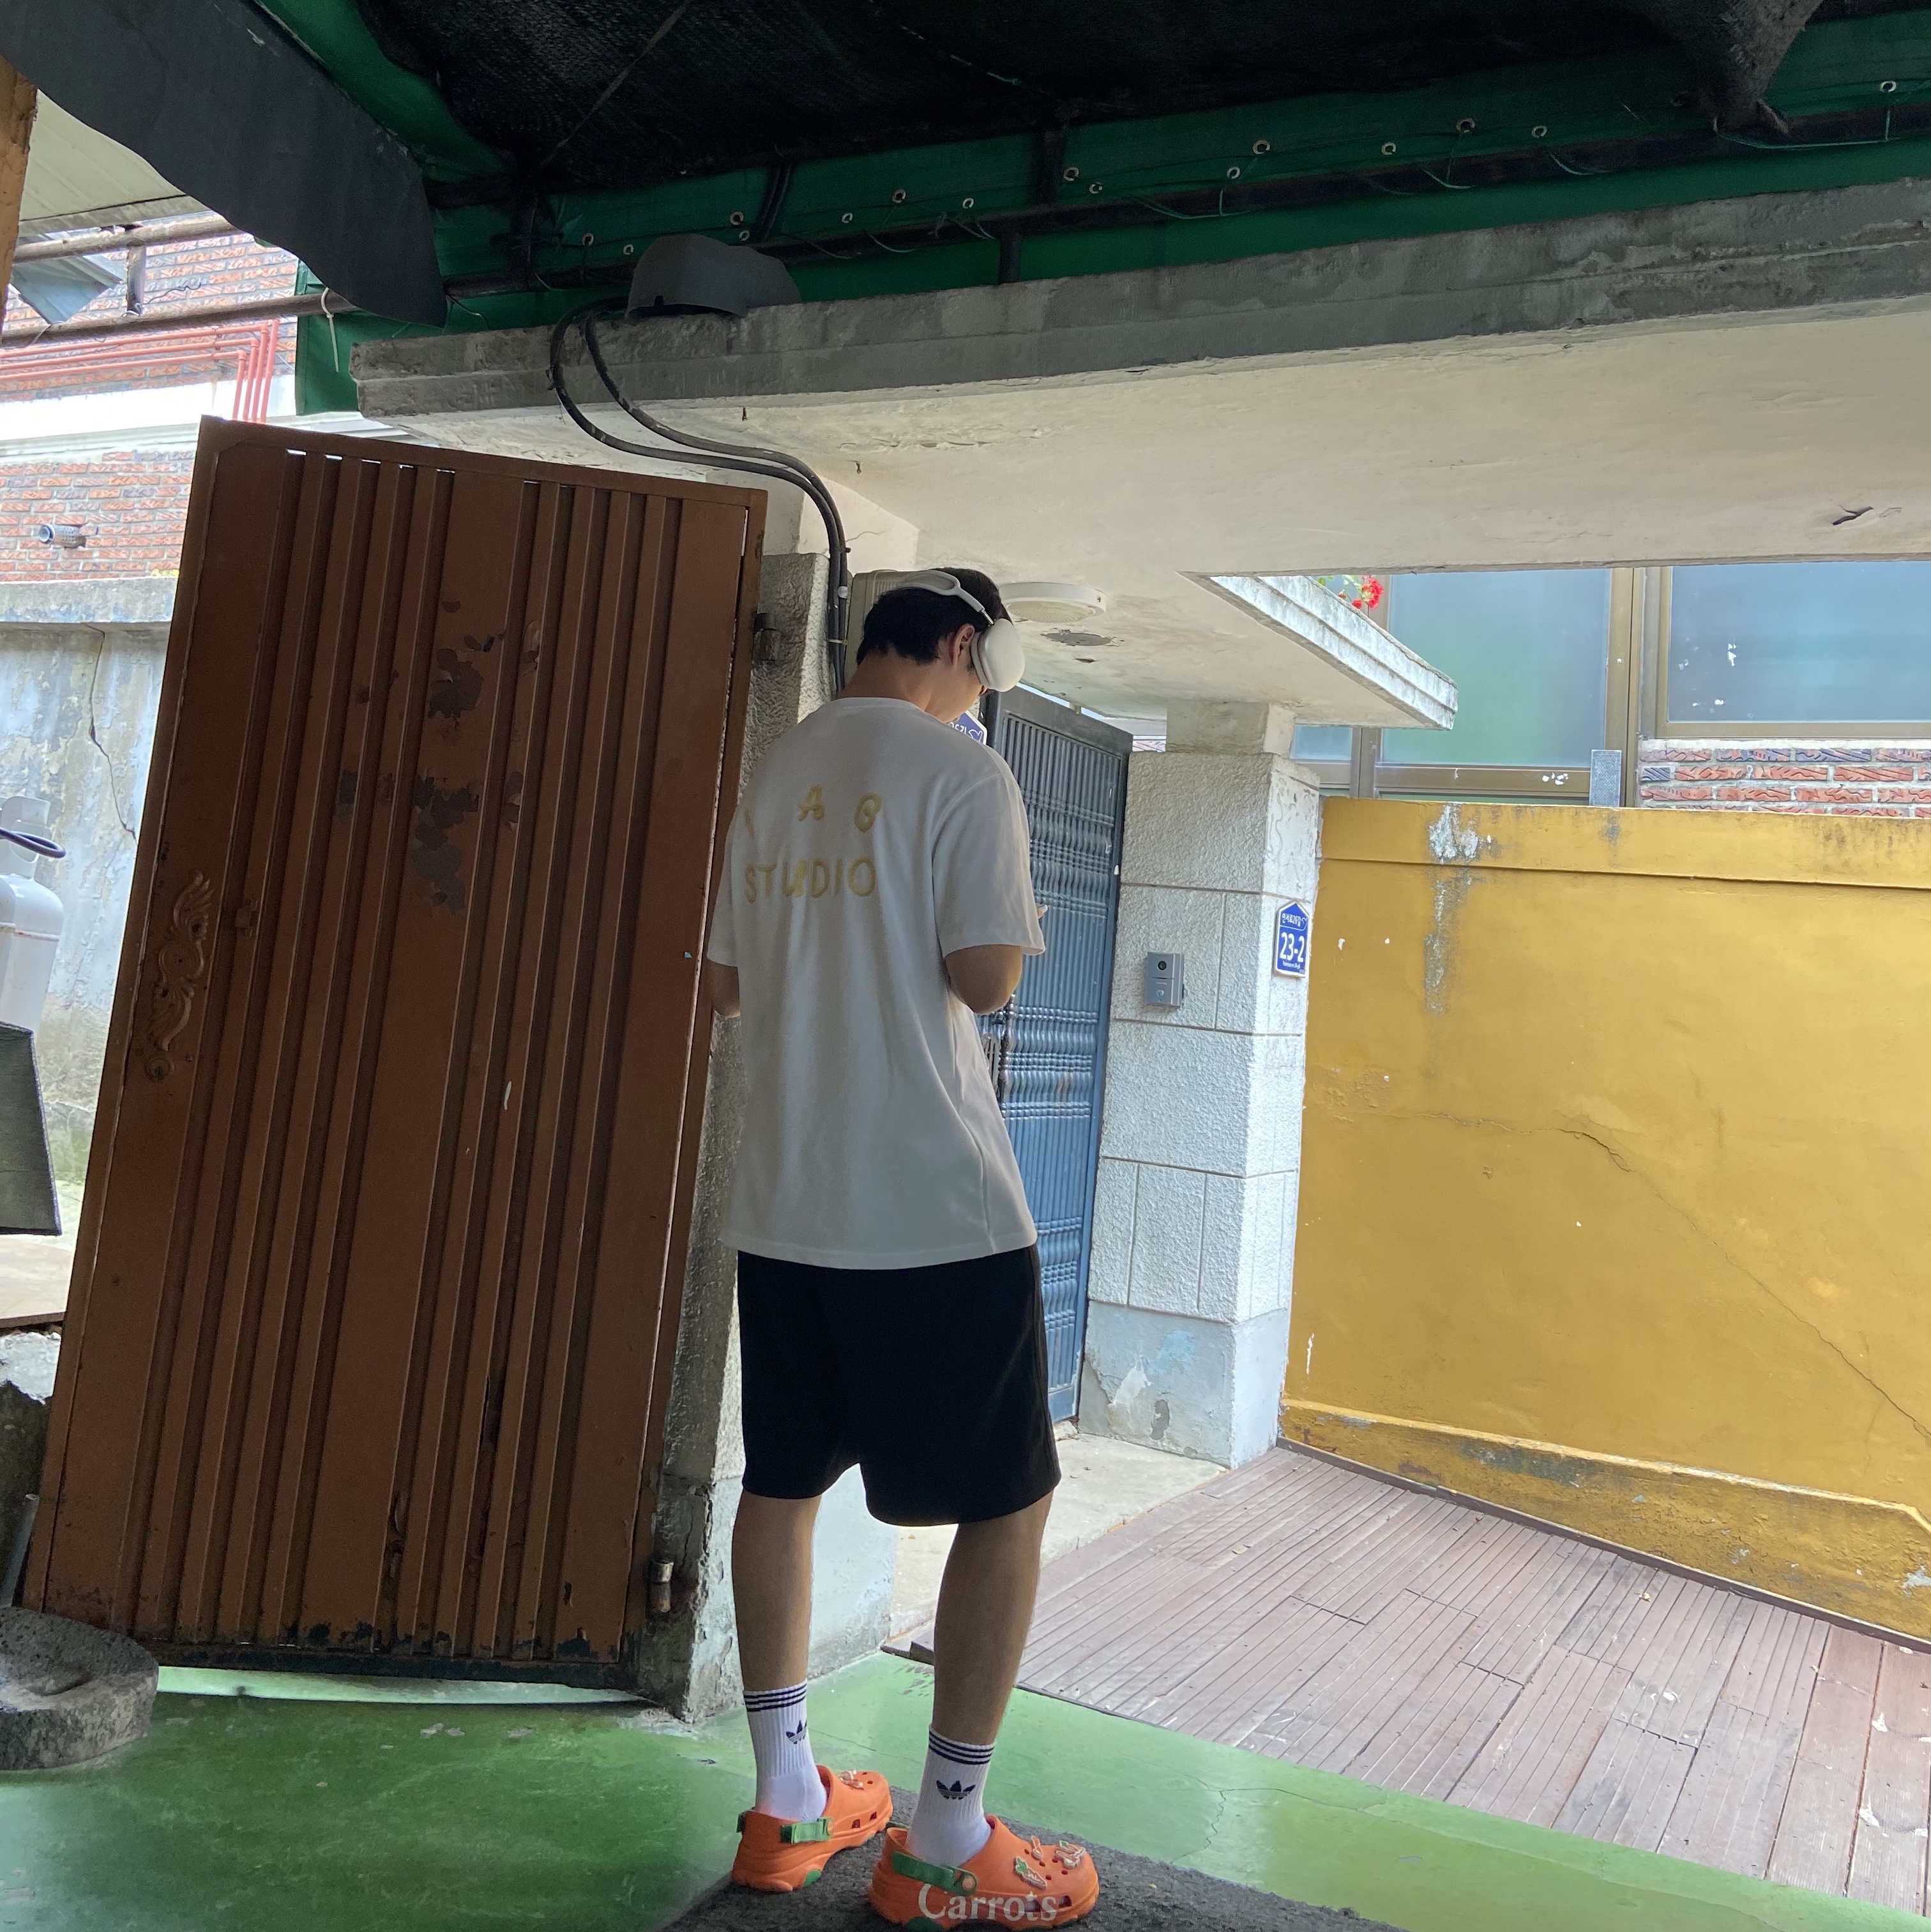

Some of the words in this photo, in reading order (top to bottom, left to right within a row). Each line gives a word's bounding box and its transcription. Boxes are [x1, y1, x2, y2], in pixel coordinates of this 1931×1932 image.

[745, 855, 877, 903] STUDIO
[1280, 932, 1305, 962] 23-2
[918, 1883, 1057, 1922] Carrots
